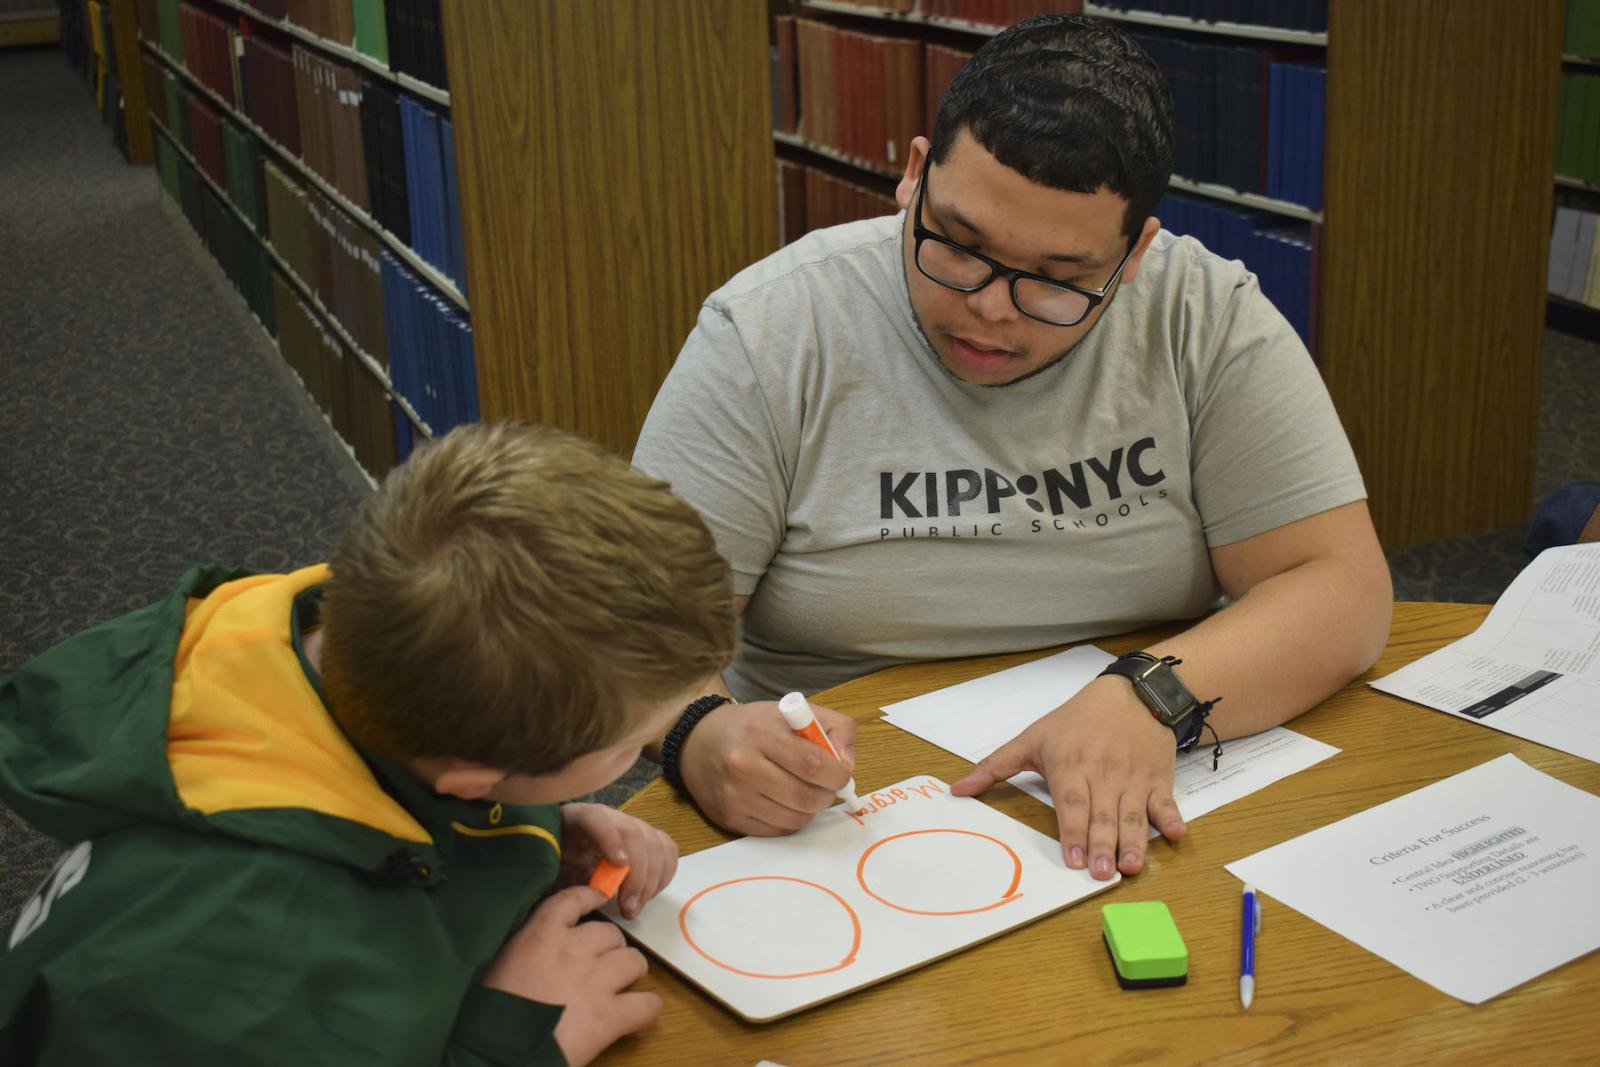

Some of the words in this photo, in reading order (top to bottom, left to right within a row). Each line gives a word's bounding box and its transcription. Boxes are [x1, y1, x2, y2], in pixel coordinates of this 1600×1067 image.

[880, 523, 1003, 540] PUBLIC
[1031, 489, 1169, 533] SCHOOLS
[1369, 842, 1421, 867] Criteria
[1418, 832, 1443, 848] For
[1440, 814, 1491, 837] Success
[1396, 864, 1434, 883] Central
[1430, 857, 1455, 869] Idea
[1451, 827, 1526, 861] HIGHLIGHTED
[1414, 876, 1441, 890] TWO
[1439, 854, 1493, 881] Supporting
[1489, 843, 1525, 858] Details
[1452, 851, 1528, 886] UNDERLINED
[1465, 883, 1485, 896] and
